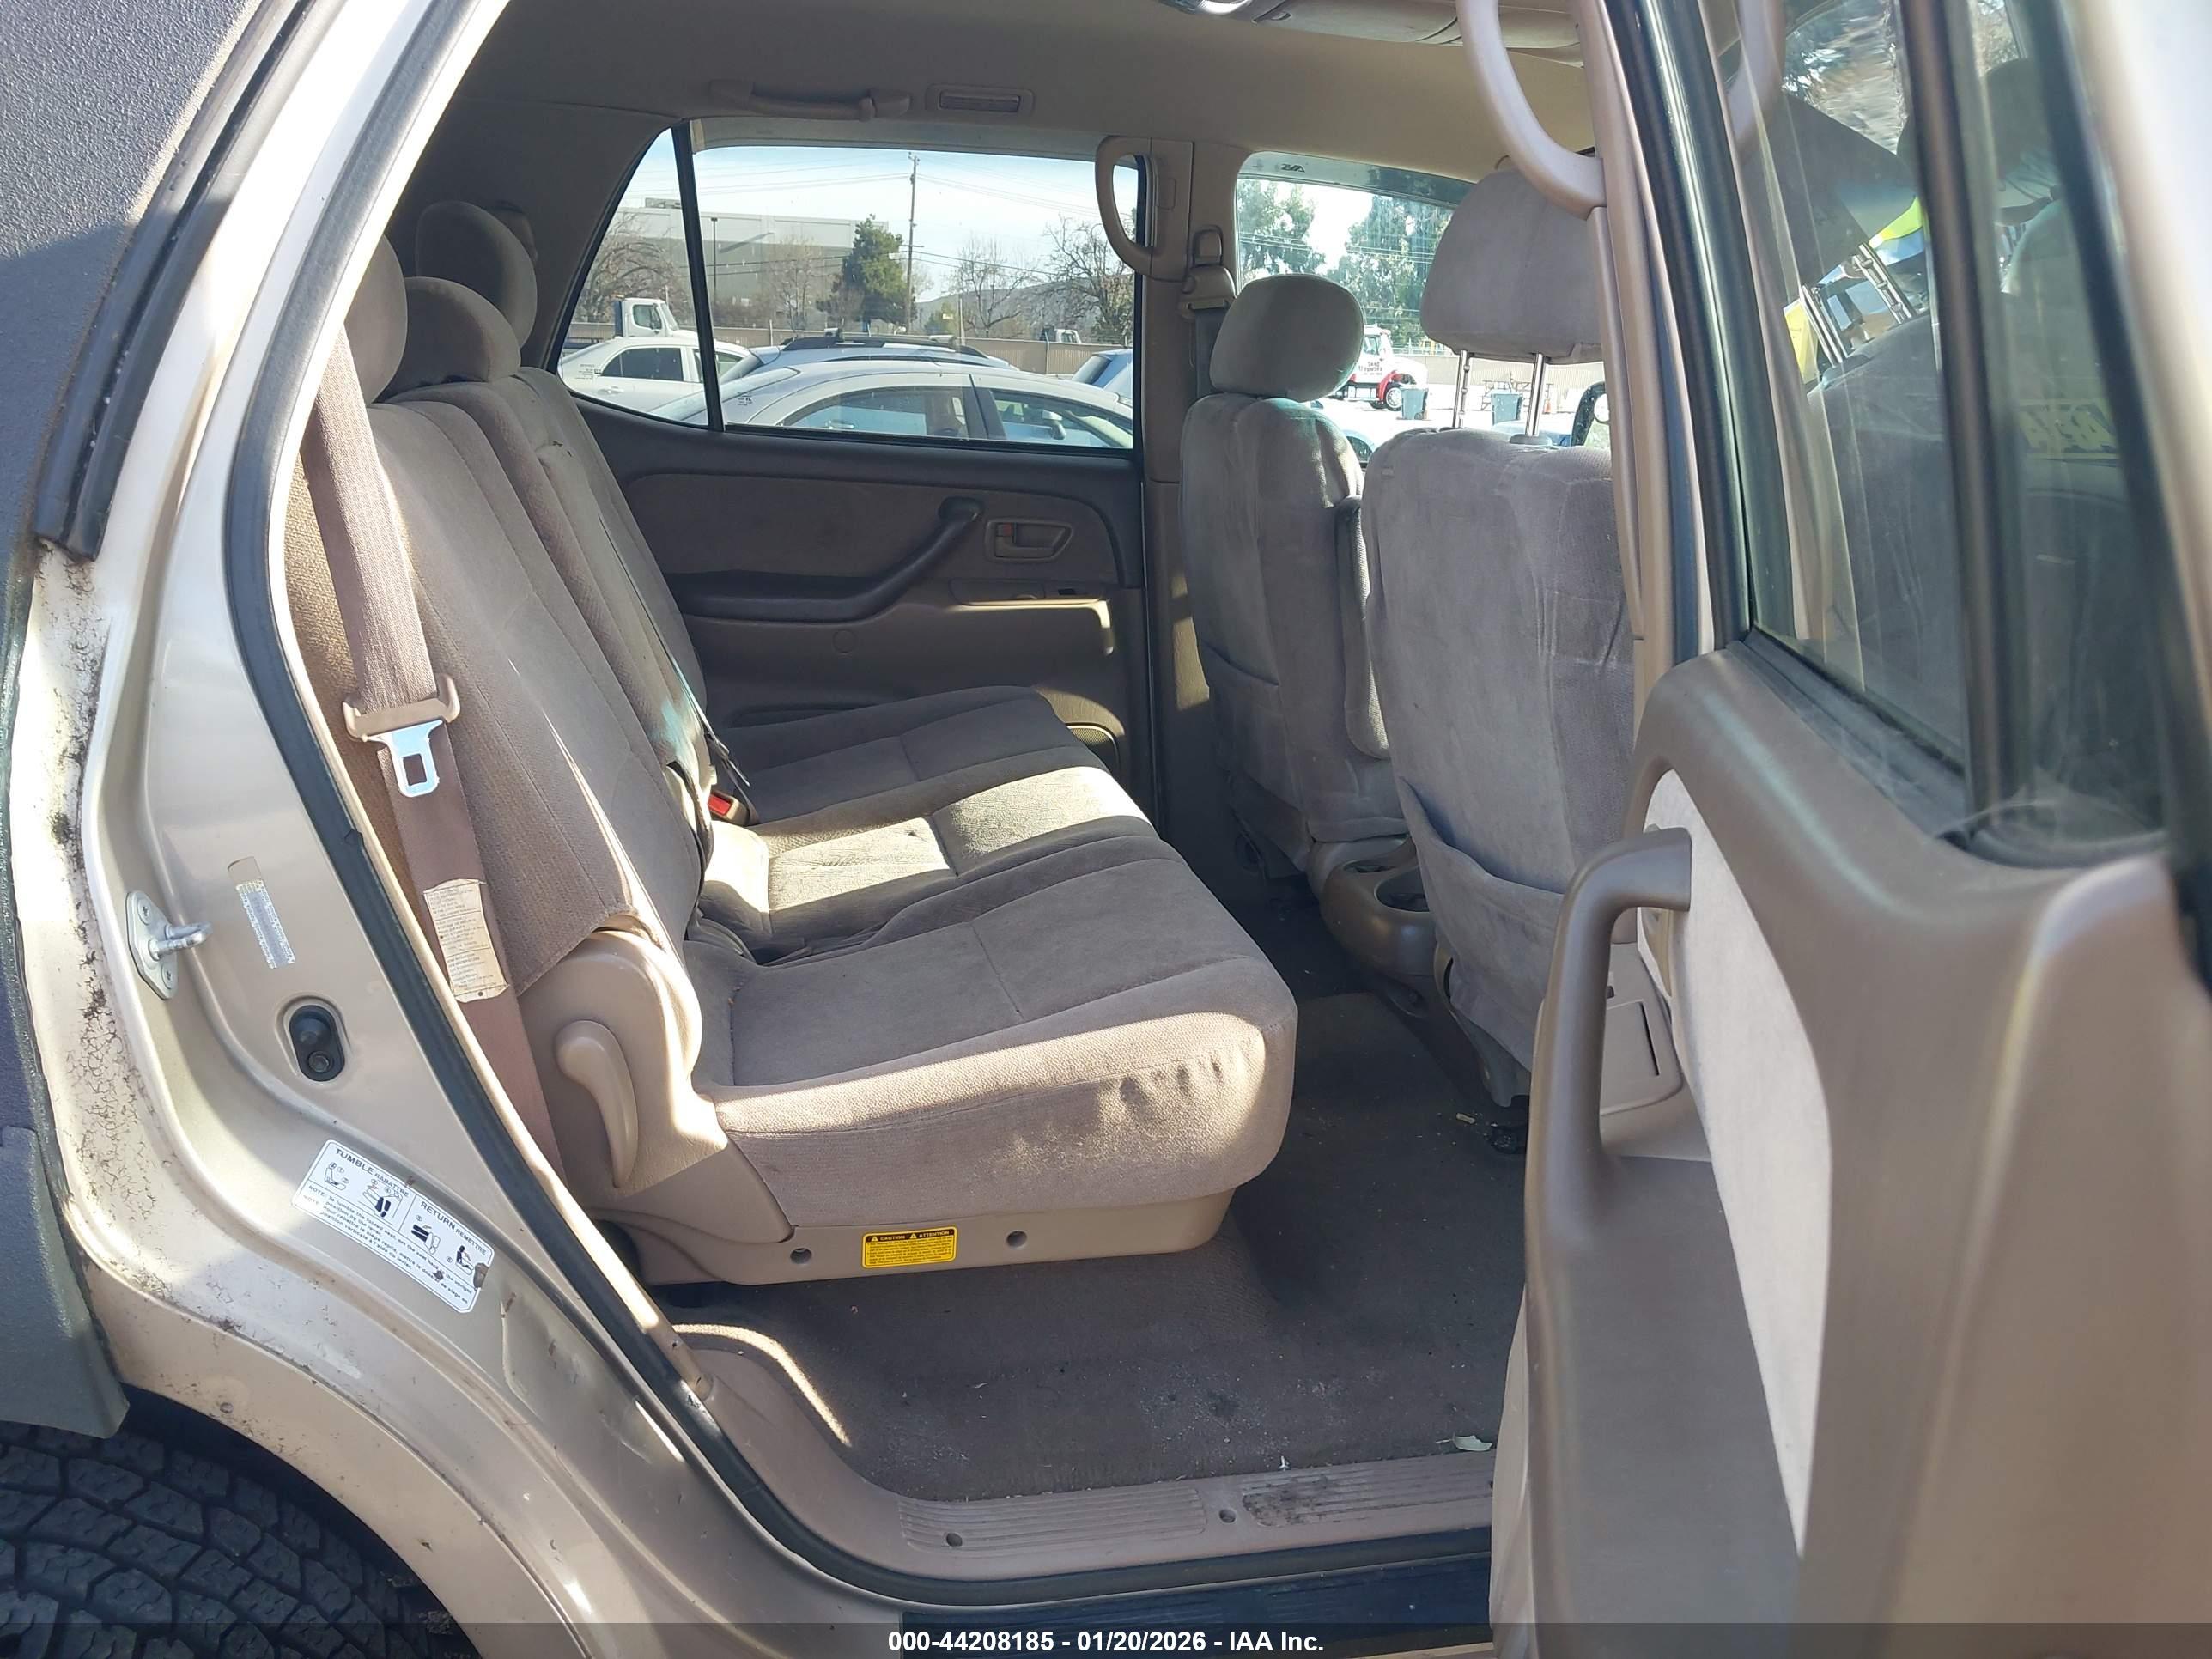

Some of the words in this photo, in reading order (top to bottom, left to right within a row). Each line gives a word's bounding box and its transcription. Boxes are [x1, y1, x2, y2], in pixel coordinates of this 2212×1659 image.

[334, 1147, 375, 1175] TUMBLE
[374, 1172, 410, 1197] RABATTRE
[420, 1201, 456, 1231] RETURN
[455, 1229, 488, 1255] REMETTRE
